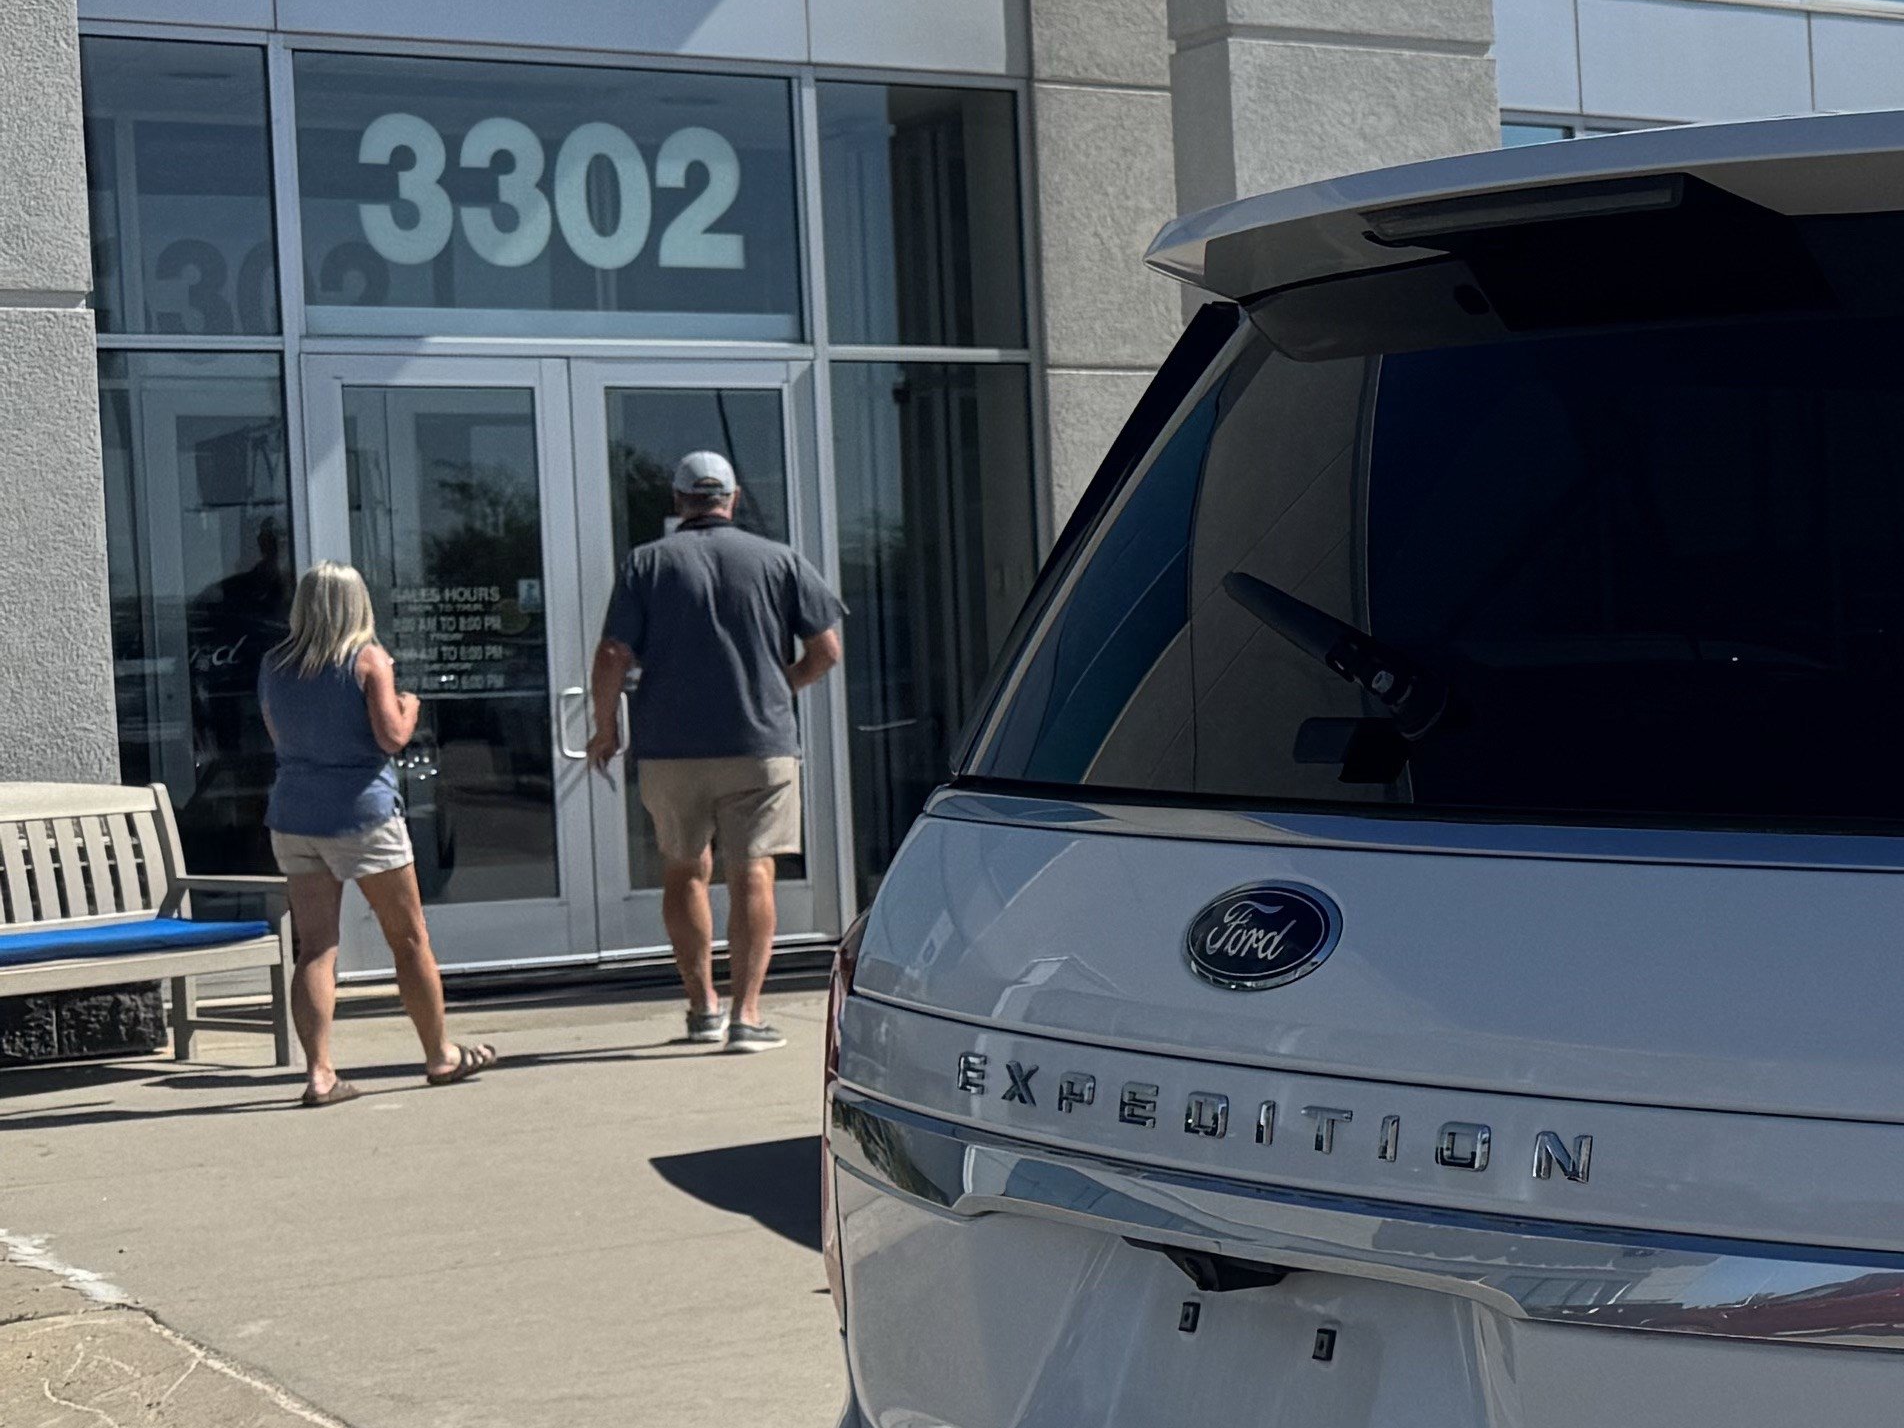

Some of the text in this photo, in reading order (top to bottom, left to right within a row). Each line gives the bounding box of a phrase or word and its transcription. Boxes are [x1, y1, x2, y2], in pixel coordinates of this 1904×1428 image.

[358, 113, 744, 270] 3302
[445, 586, 500, 602] HOURS
[1206, 900, 1297, 961] Ford
[958, 1051, 1594, 1184] EXPEDITION
